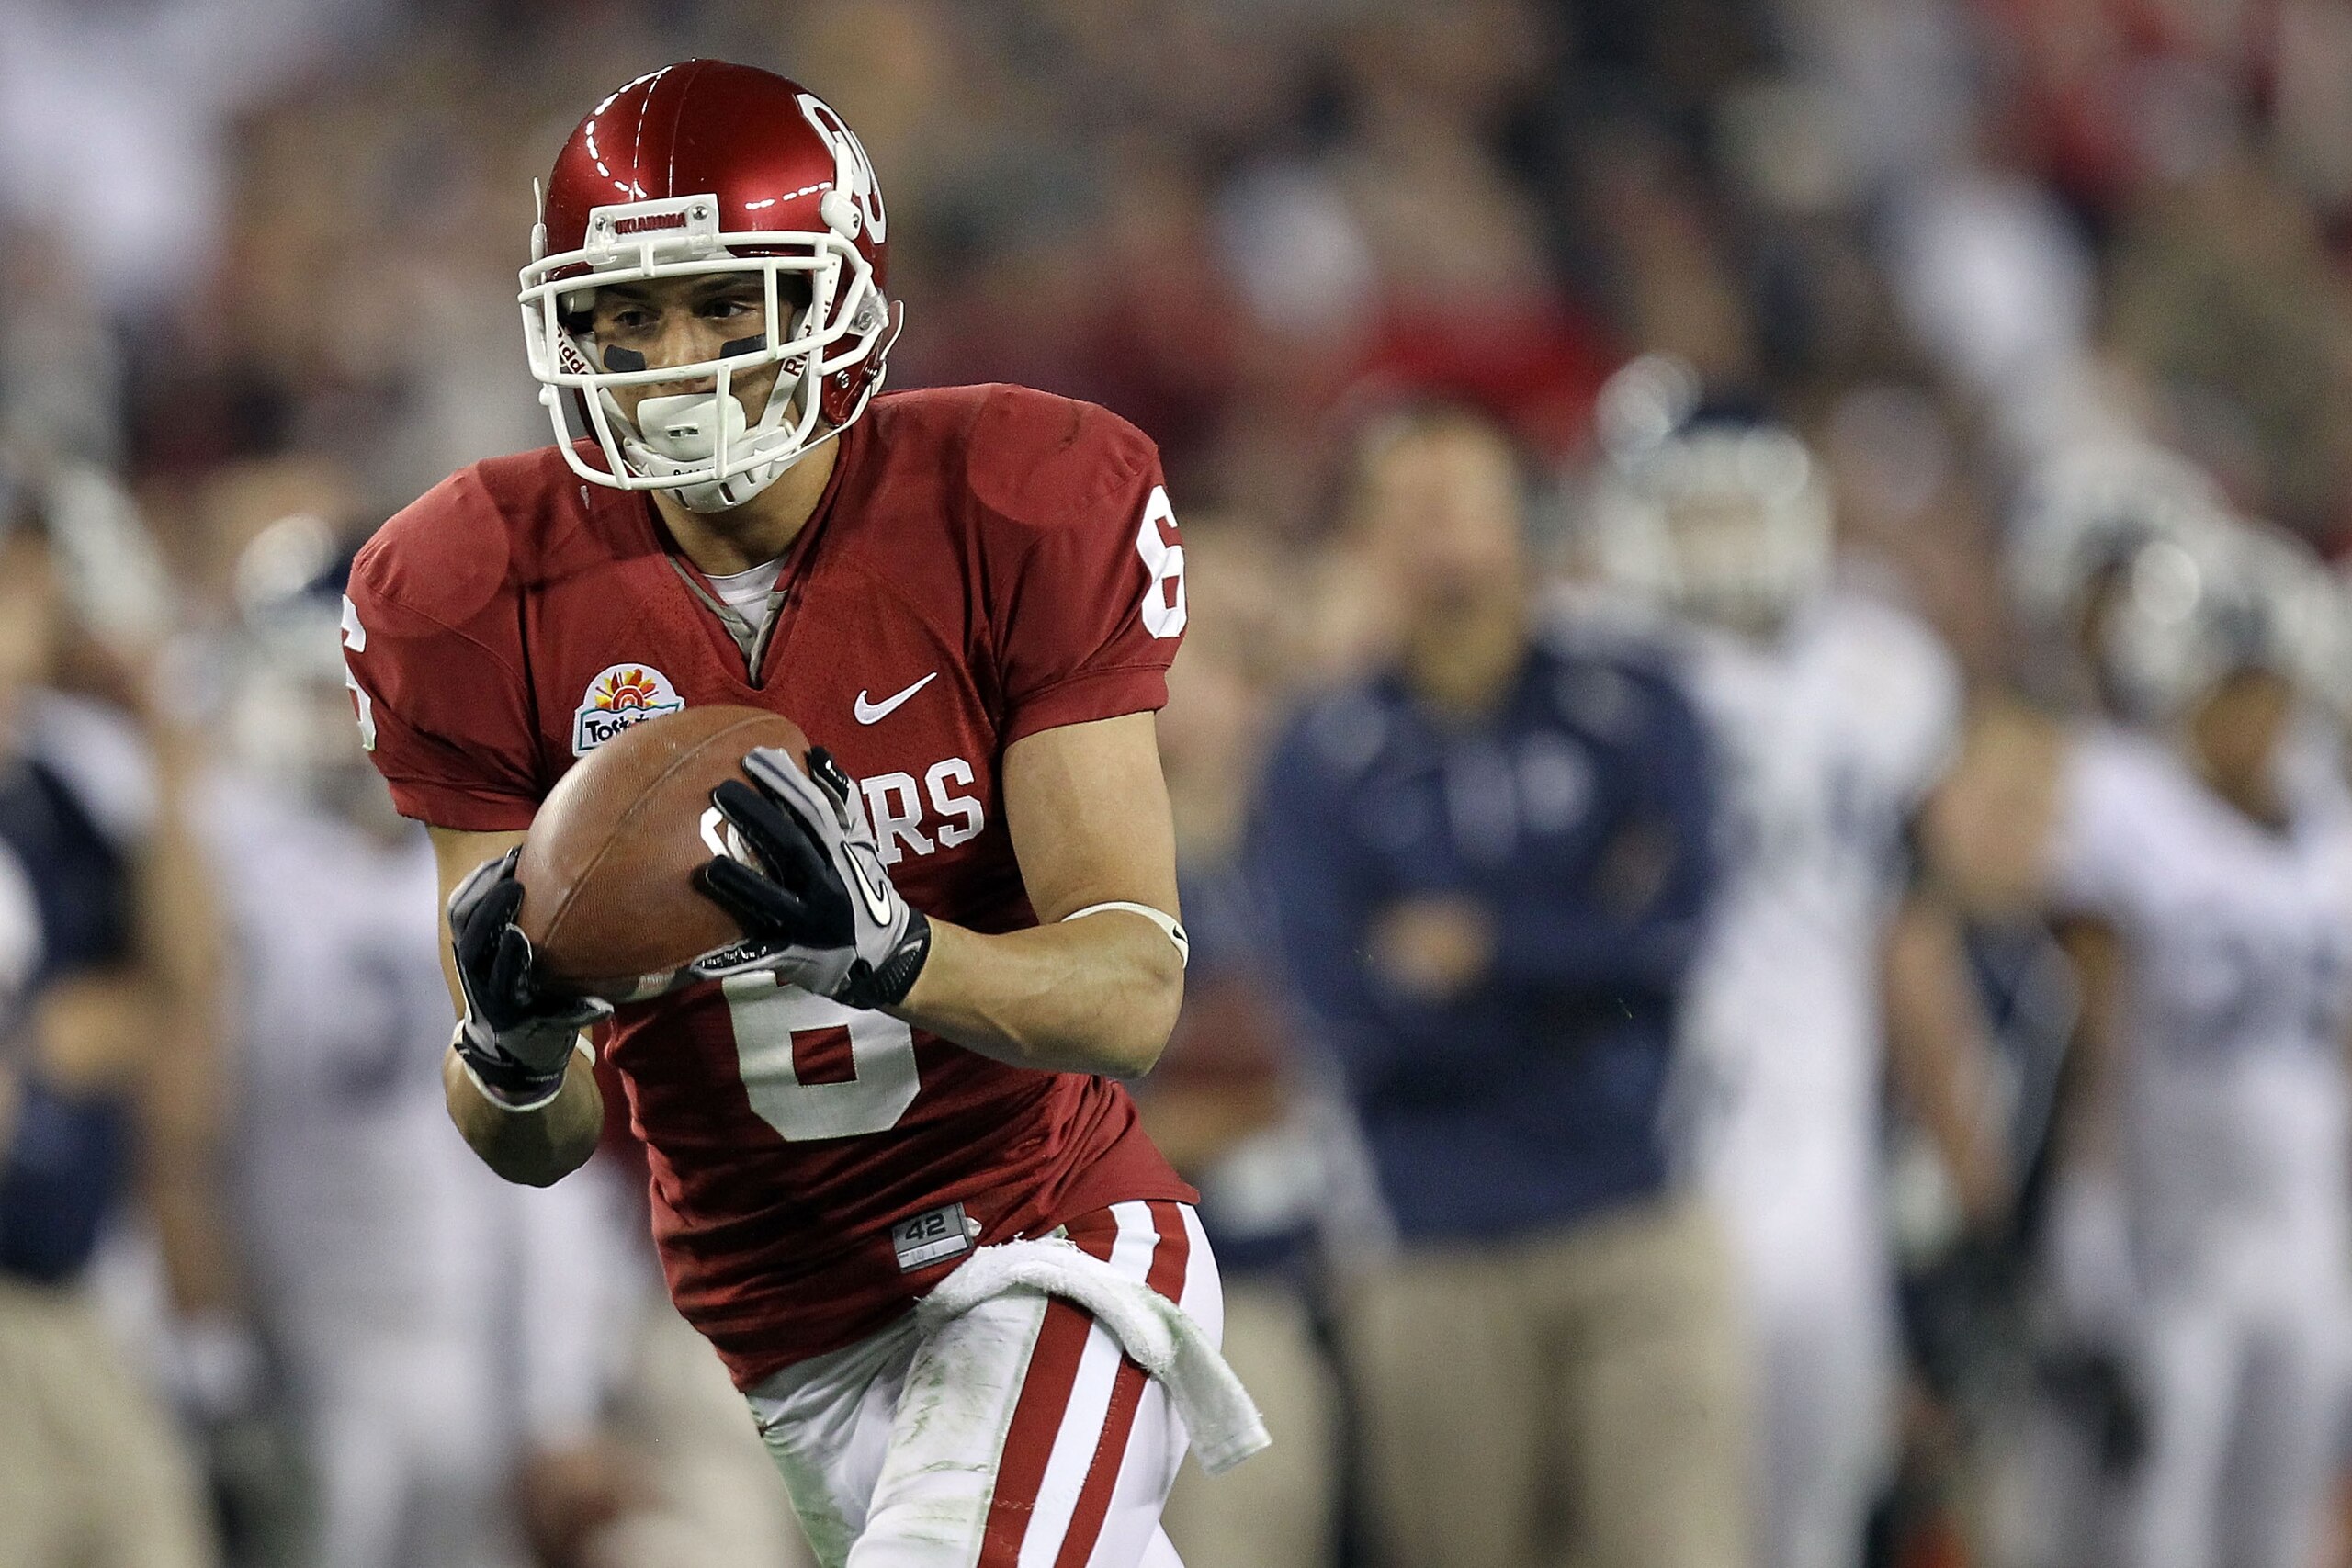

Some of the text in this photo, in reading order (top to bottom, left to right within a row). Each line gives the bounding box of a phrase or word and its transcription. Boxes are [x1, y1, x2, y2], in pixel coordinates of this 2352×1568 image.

[1136, 485, 1188, 639] 6
[722, 969, 921, 1142] 6
[905, 1213, 946, 1240] 42
